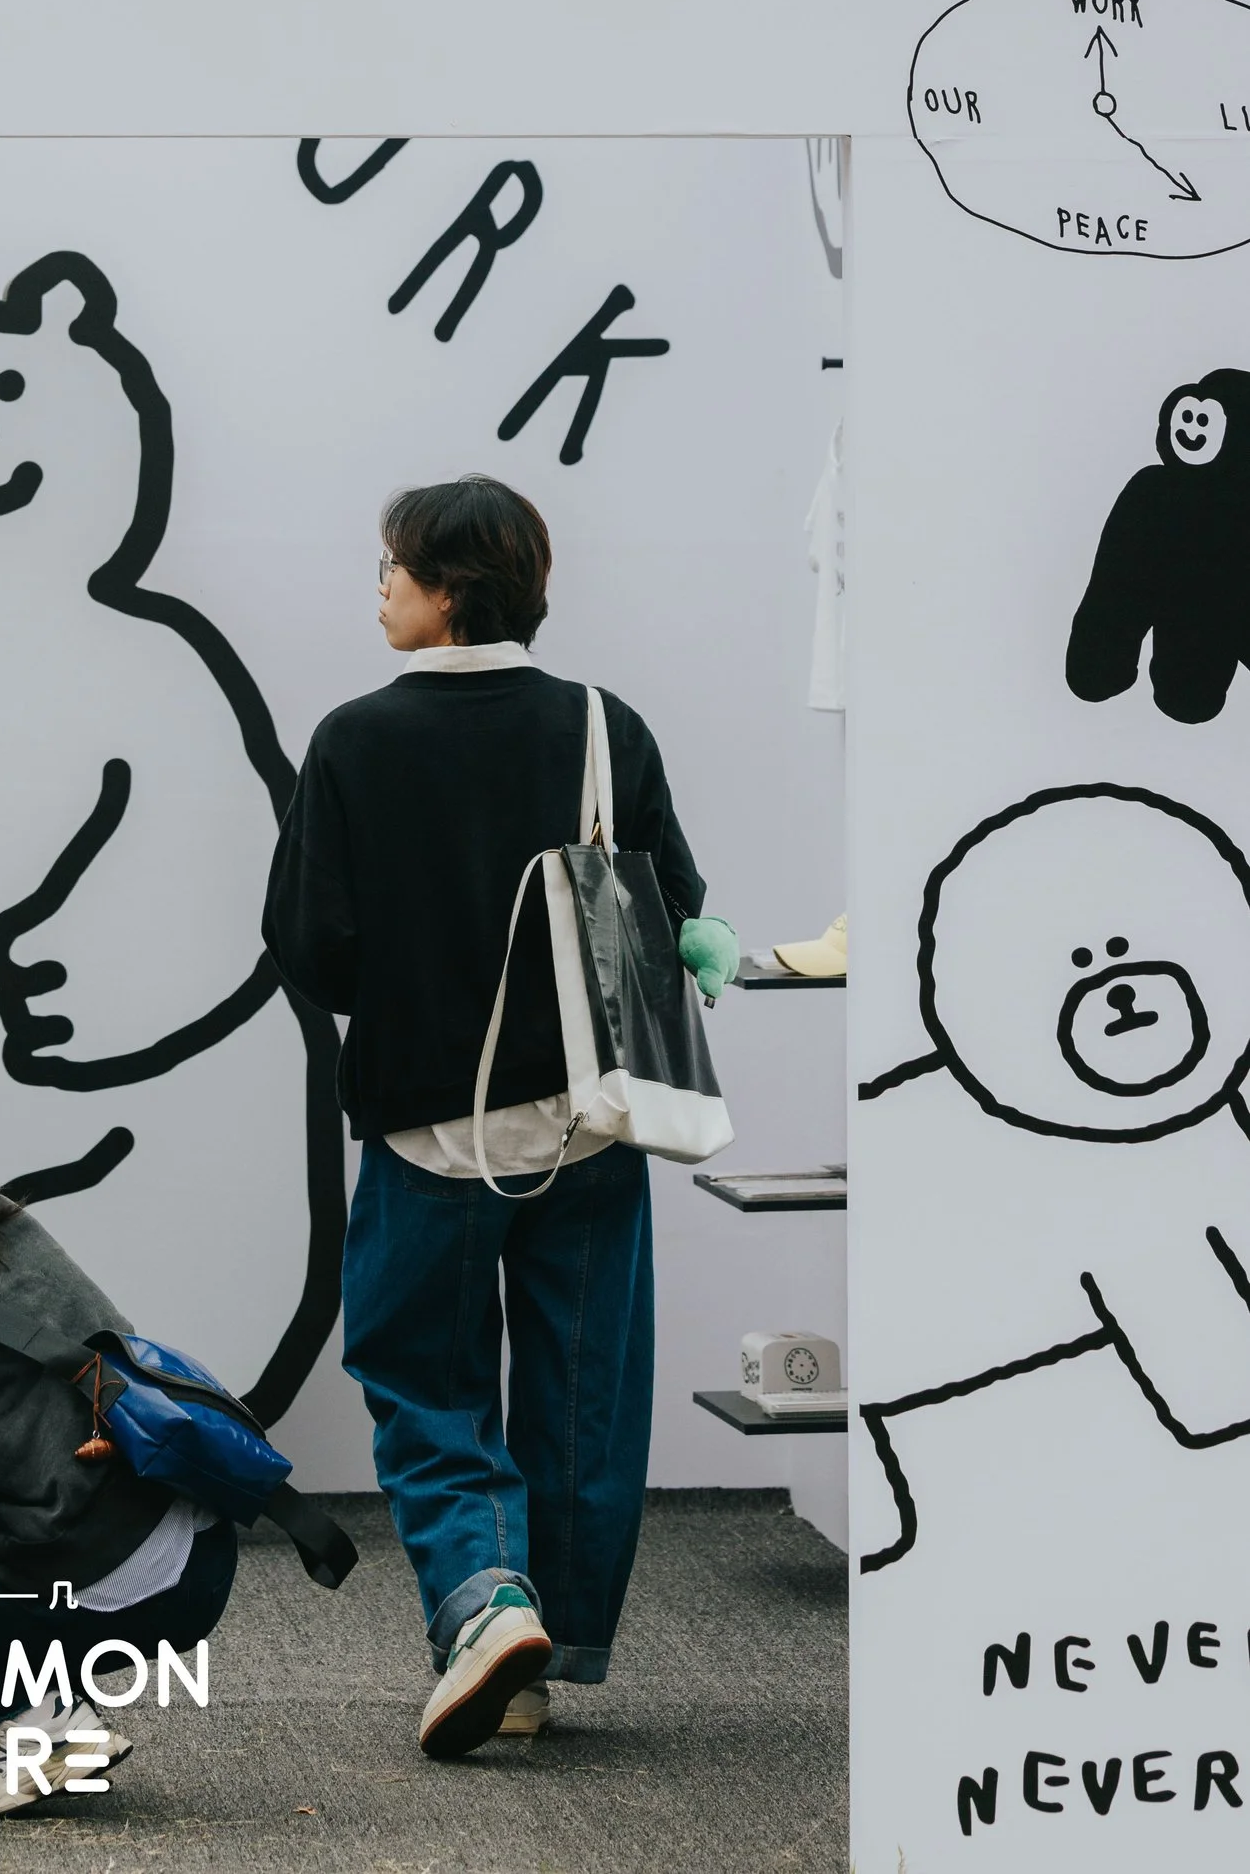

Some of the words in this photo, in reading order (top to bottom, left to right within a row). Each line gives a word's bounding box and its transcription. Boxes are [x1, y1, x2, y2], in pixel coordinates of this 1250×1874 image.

[923, 85, 983, 124] OUR
[1055, 206, 1150, 247] PEACE
[982, 1620, 1250, 1697] NEVE
[957, 1749, 1245, 1837] NEVER
